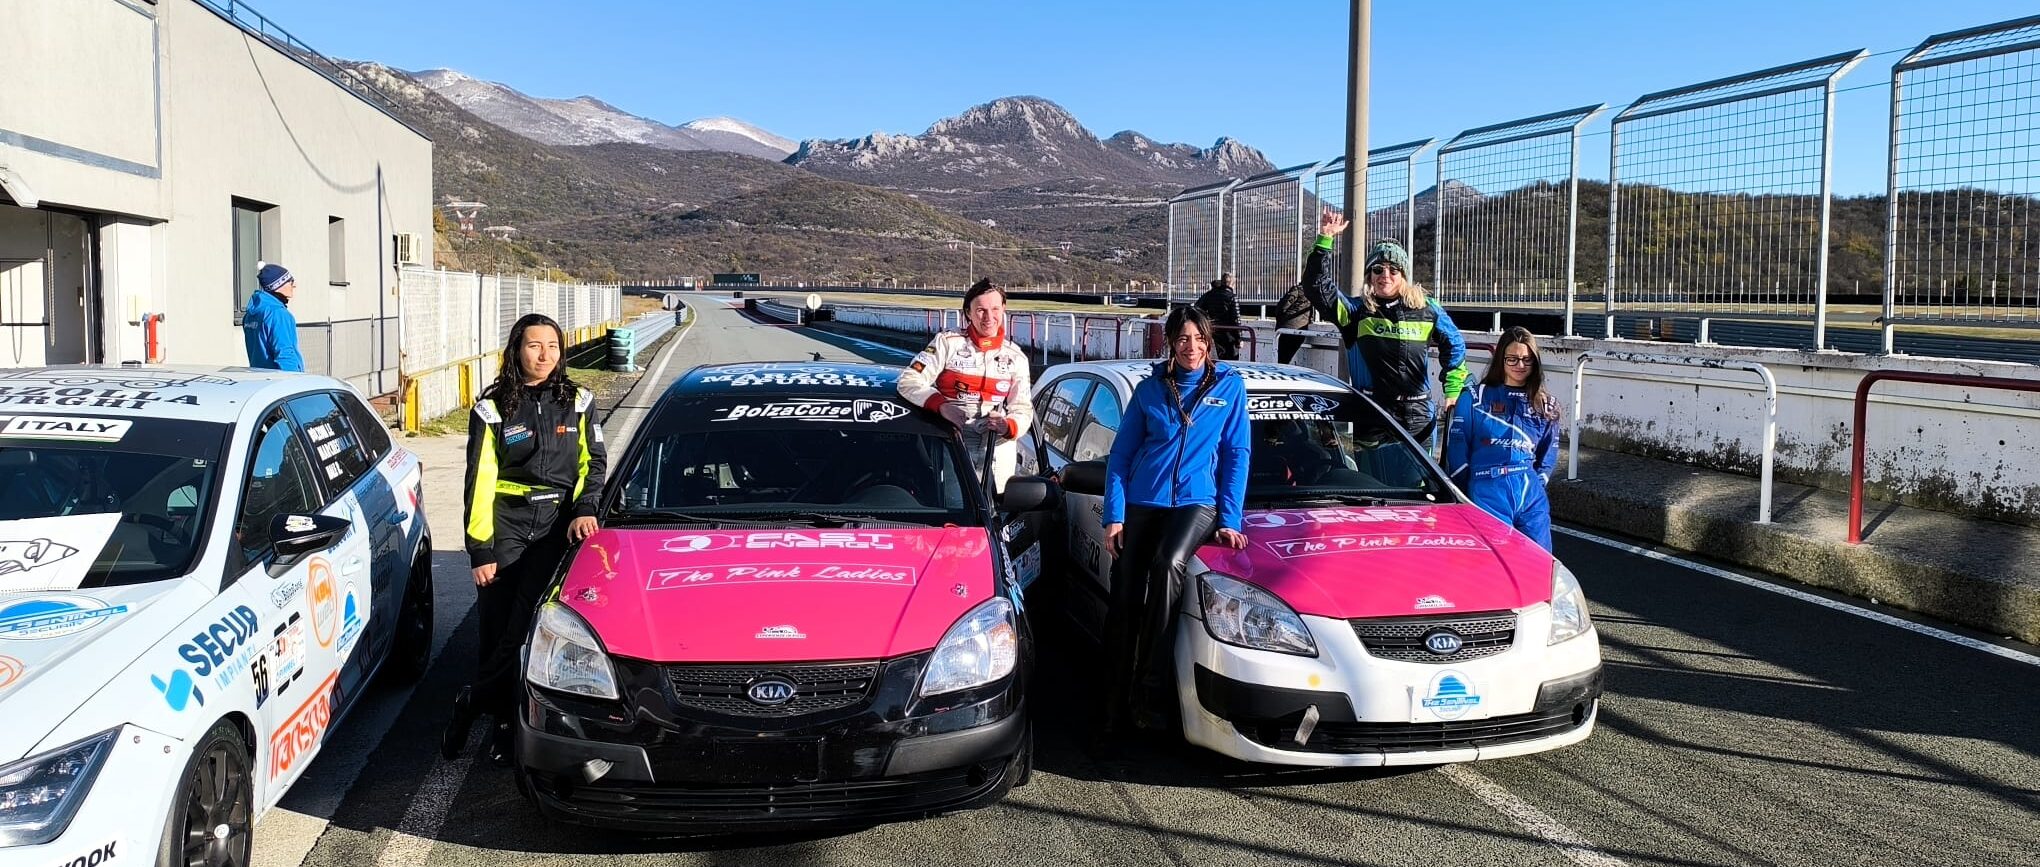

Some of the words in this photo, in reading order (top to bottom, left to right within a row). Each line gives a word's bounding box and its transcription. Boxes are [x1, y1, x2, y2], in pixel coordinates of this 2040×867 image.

[731, 378, 884, 388] SPURGHI
[1246, 399, 1294, 409] Corse
[727, 404, 853, 419] BolzaCorse
[1249, 413, 1277, 421] ENZE
[16, 420, 119, 433] ITALY
[747, 532, 893, 543] FAST
[1276, 541, 1327, 555] The
[1331, 535, 1396, 549] Pink
[1407, 533, 1476, 548] Ladies
[658, 570, 715, 586] The
[727, 565, 802, 581] Pink
[814, 565, 907, 582] Ladies
[178, 604, 260, 677] SECUR
[1432, 636, 1458, 649] KIA
[214, 642, 257, 692] IMPIANTI
[250, 654, 270, 706] 56
[756, 685, 788, 699] KIA
